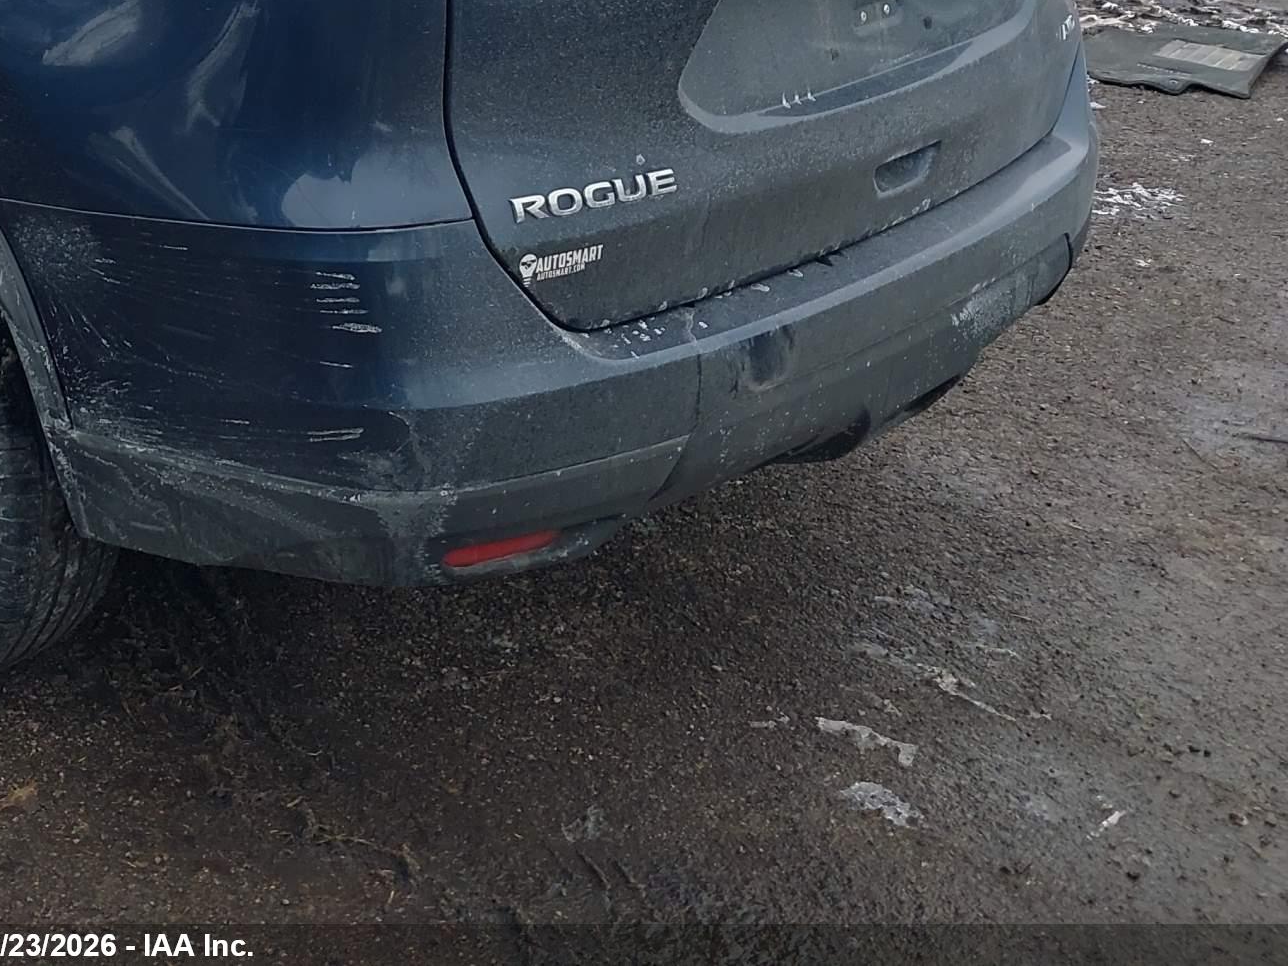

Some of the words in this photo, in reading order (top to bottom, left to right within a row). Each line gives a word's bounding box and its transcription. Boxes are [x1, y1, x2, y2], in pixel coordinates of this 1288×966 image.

[510, 168, 678, 224] ROGUE
[535, 244, 604, 274] AUTOSMART
[536, 263, 586, 281] AUTOSMART.COM
